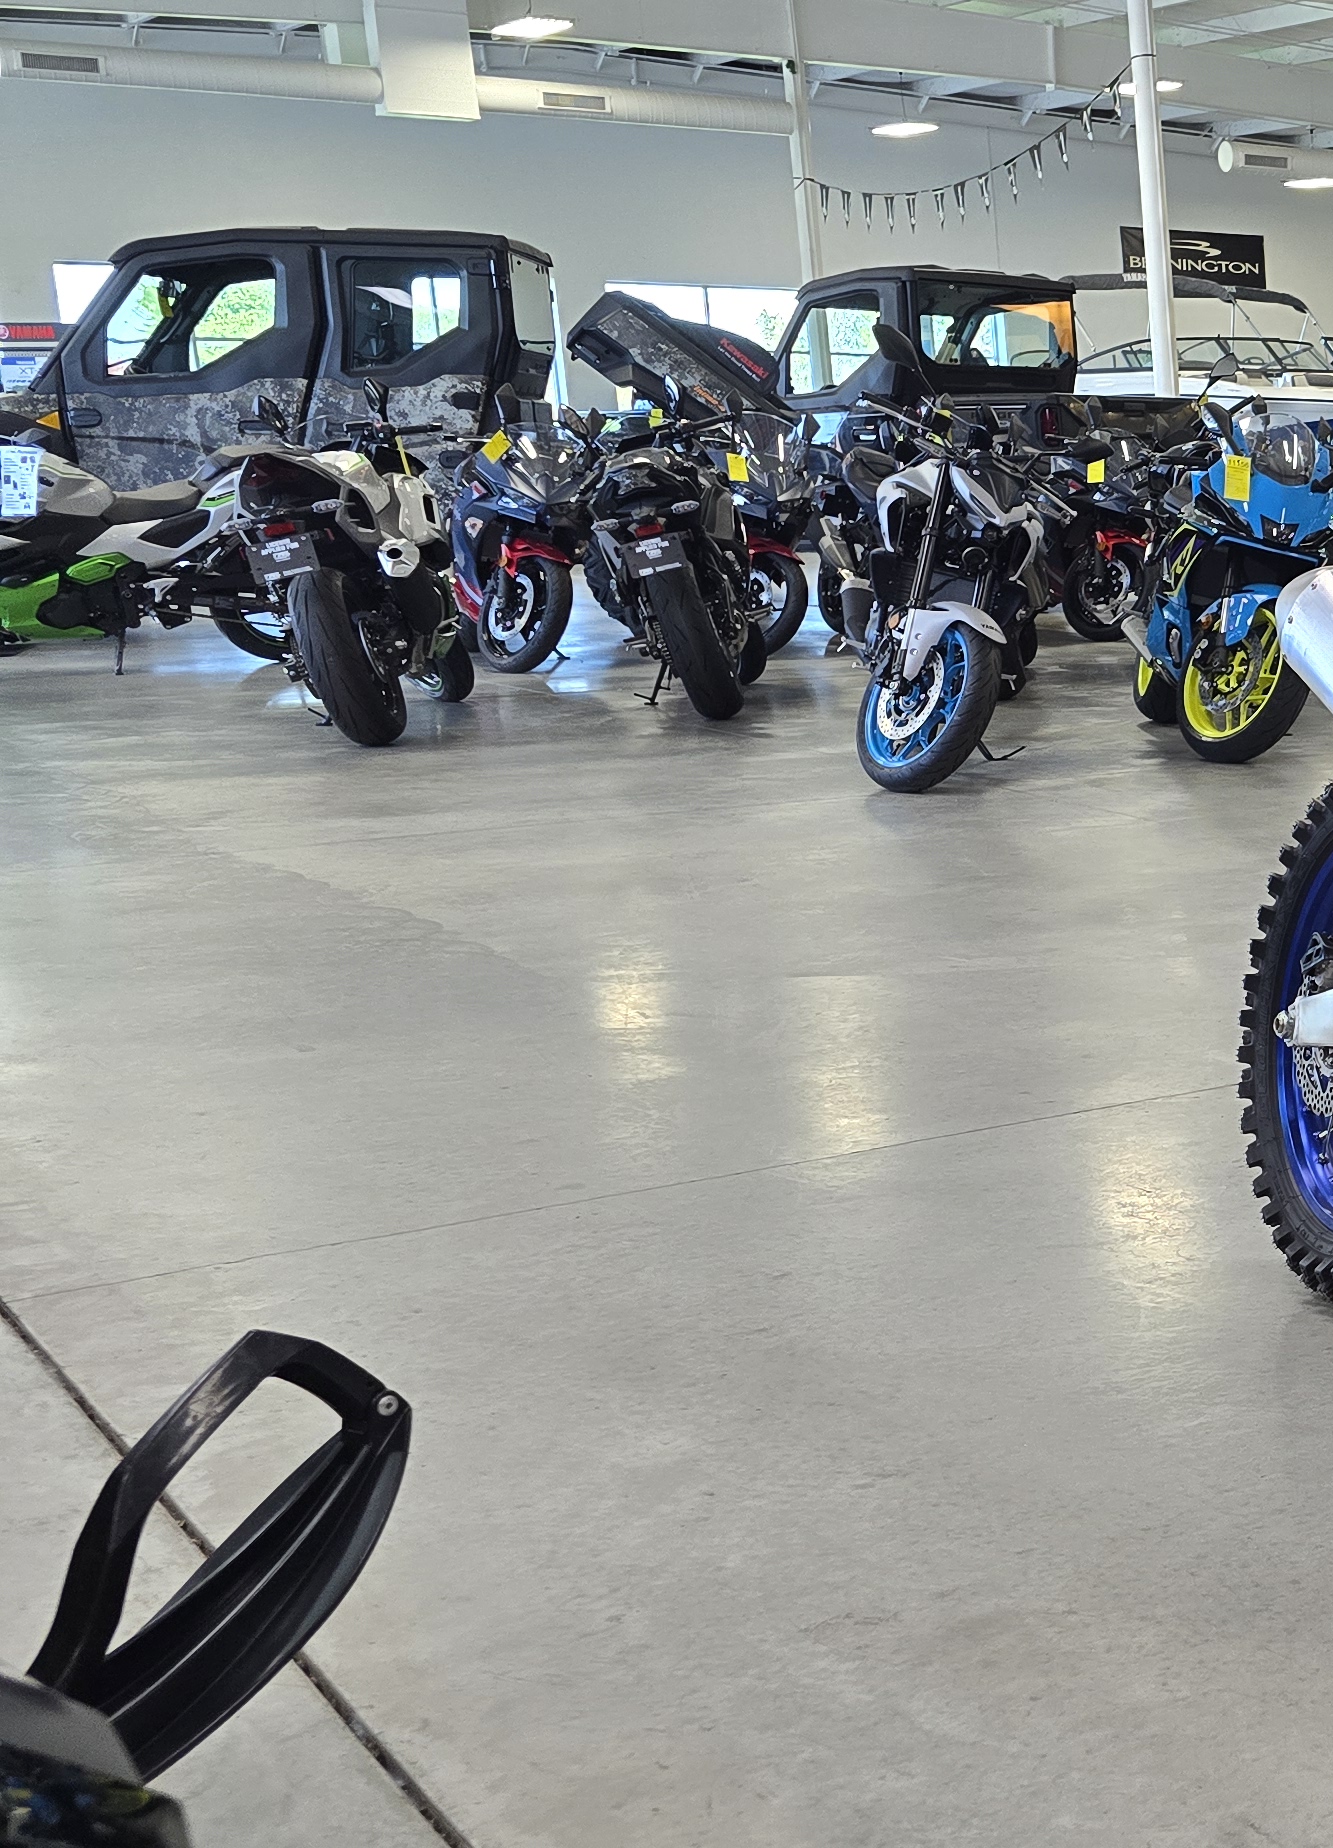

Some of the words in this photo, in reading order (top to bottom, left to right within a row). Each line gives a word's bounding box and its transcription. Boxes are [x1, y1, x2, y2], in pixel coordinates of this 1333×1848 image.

[1129, 255, 1259, 275] BNINGTON
[9, 326, 55, 339] YAMAHA
[719, 337, 769, 379] Kawasaki
